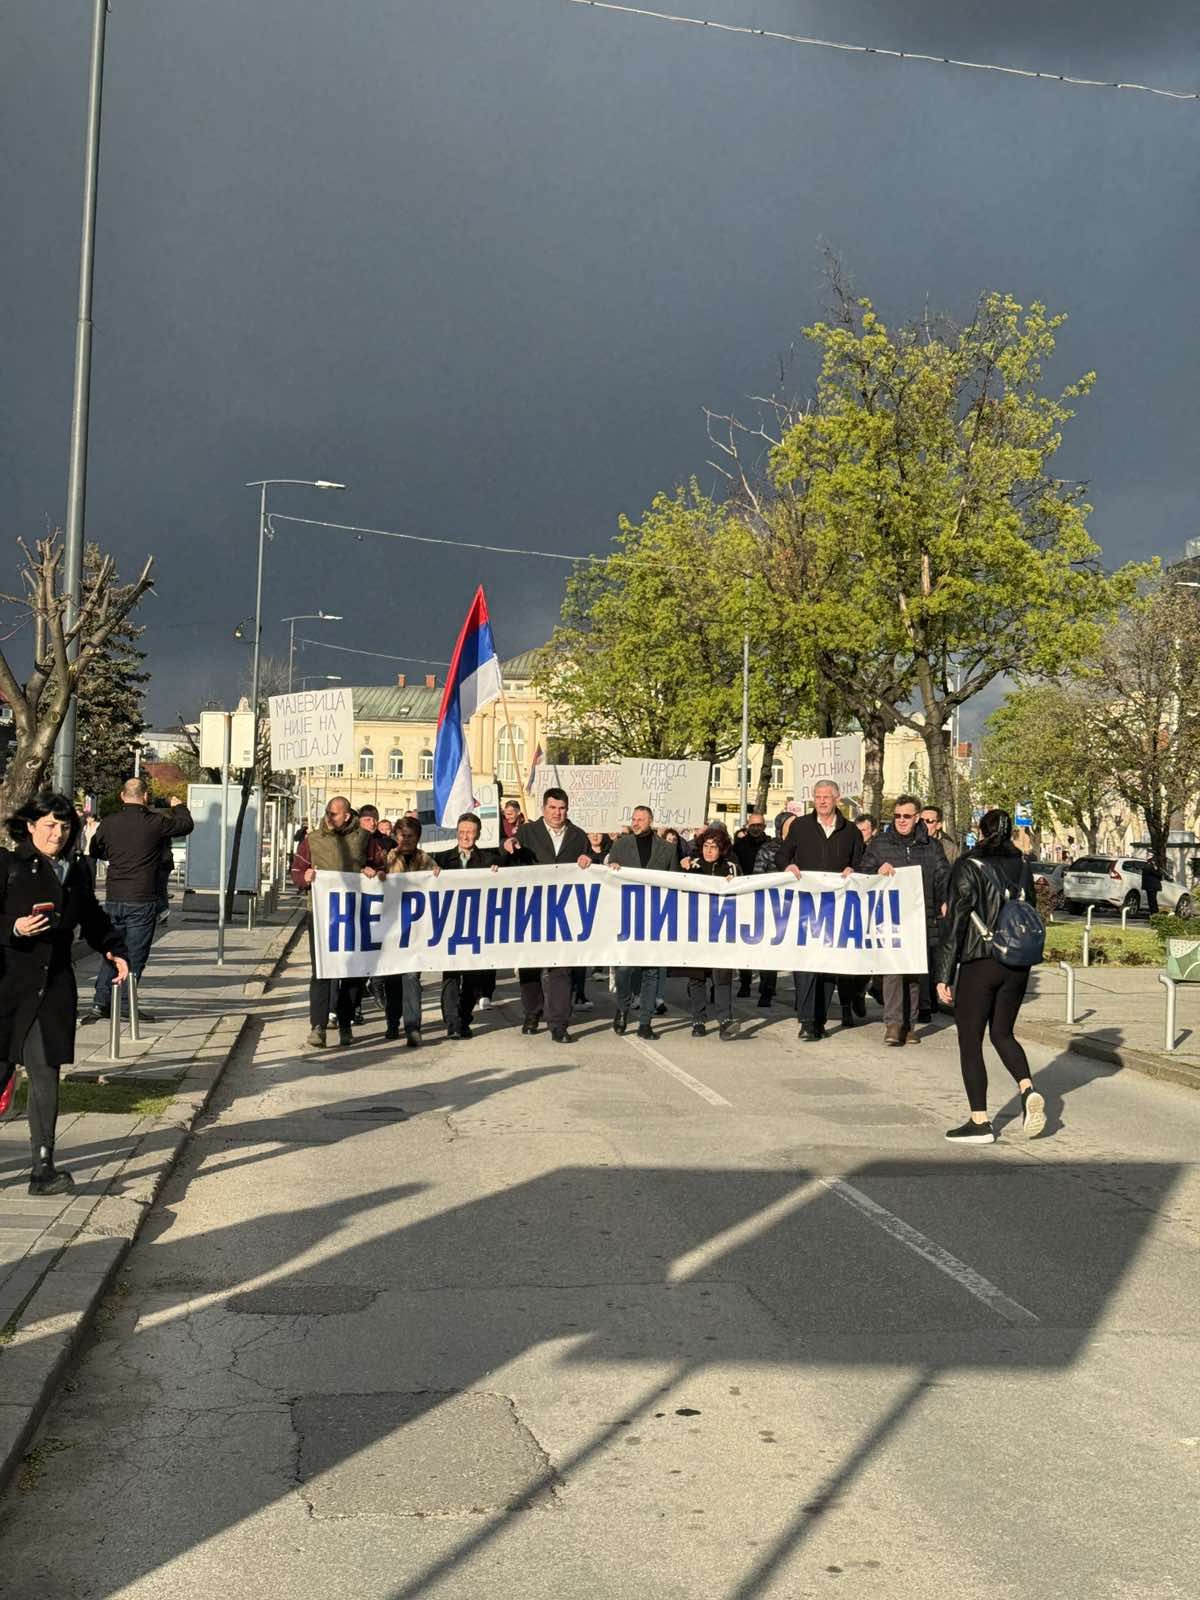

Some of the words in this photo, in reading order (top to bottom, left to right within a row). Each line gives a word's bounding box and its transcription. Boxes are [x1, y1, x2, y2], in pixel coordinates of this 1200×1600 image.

[275, 691, 346, 718] МАЈЕВИЦА
[284, 716, 313, 737] НИЈЕ
[278, 733, 342, 761] ПРОДАЈУ
[821, 739, 841, 758] НЕ
[640, 763, 687, 778] НАРОД
[801, 760, 856, 778] РУДНИКУ
[641, 777, 672, 792] КАЖЕ
[648, 792, 667, 808] НЕ
[328, 891, 386, 953] НЕ
[399, 883, 602, 956] РУДНИКУ
[616, 884, 902, 949] ЛИТИЈУМА!!!
